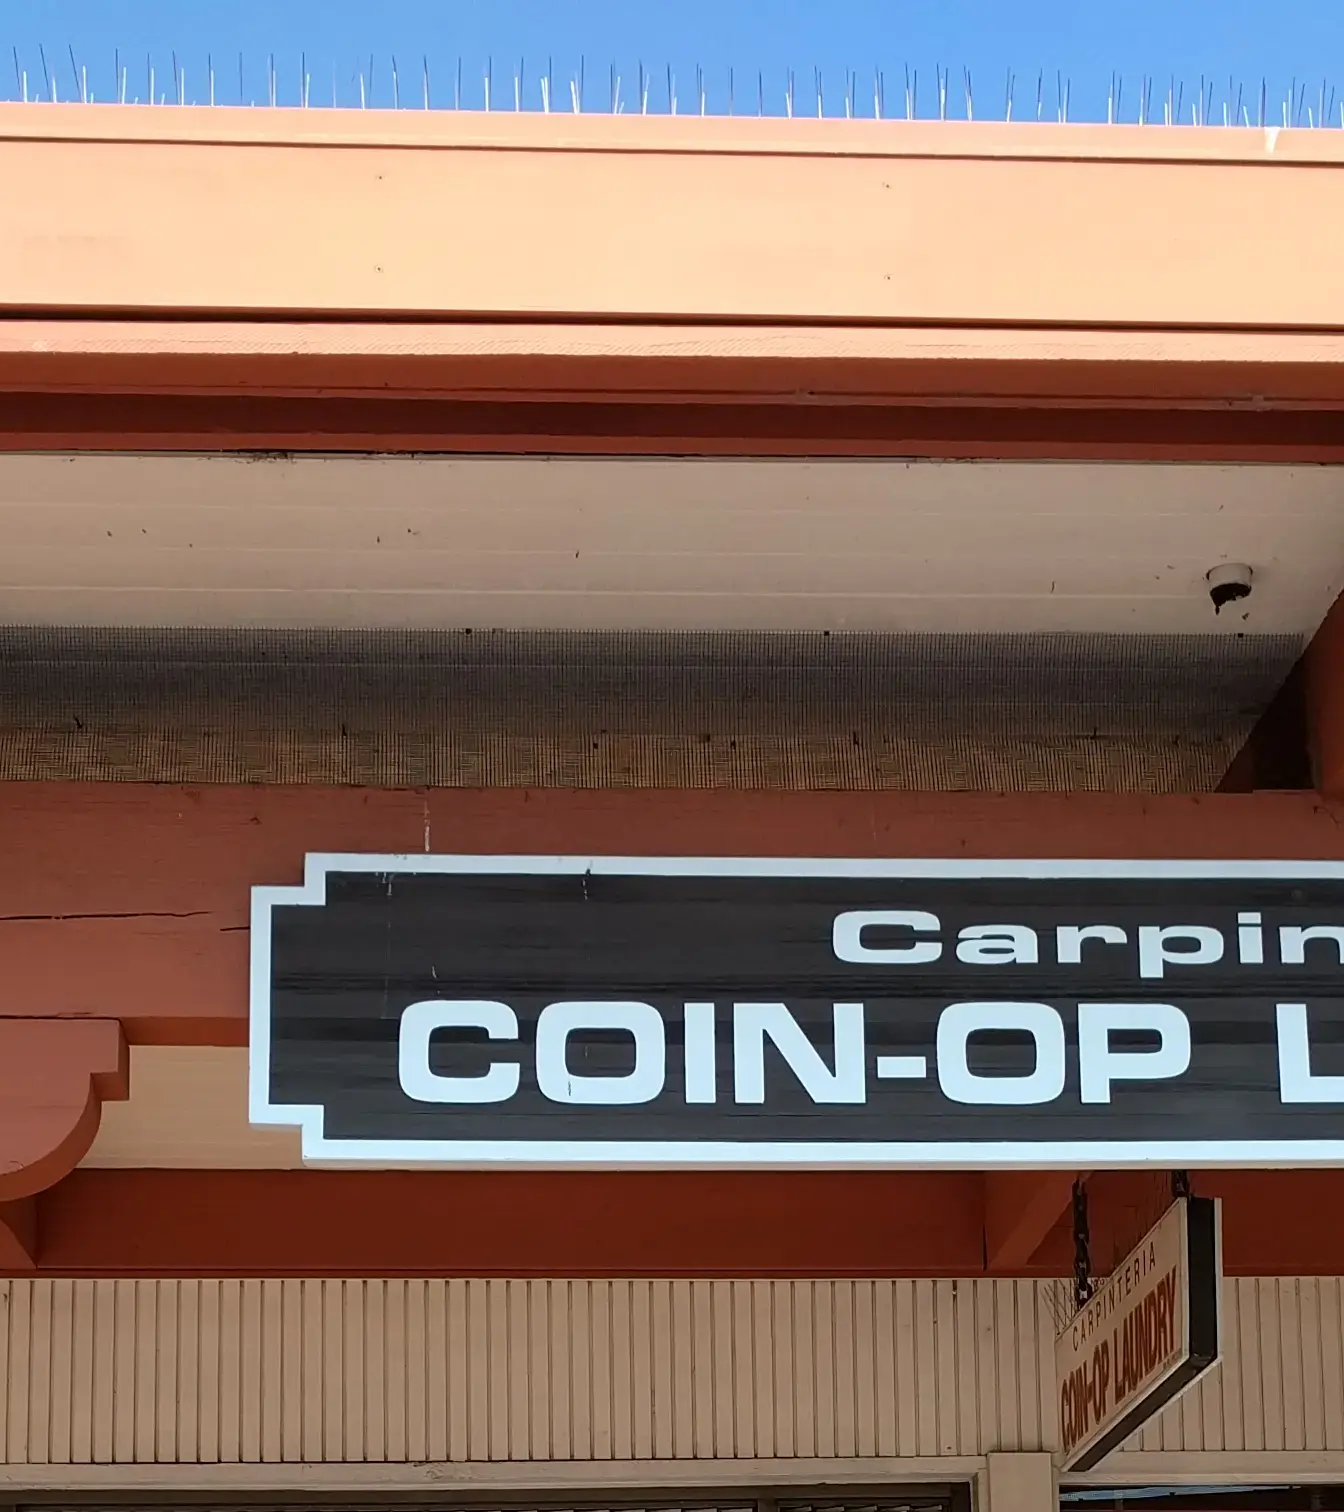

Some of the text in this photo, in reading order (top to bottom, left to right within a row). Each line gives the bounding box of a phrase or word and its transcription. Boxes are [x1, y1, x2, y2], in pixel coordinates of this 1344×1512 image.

[398, 1000, 1192, 1105] COIN-OP
[1072, 1241, 1156, 1352] CARPINTERIA
[1061, 1265, 1177, 1455] COIN-OP LAUNDRY
